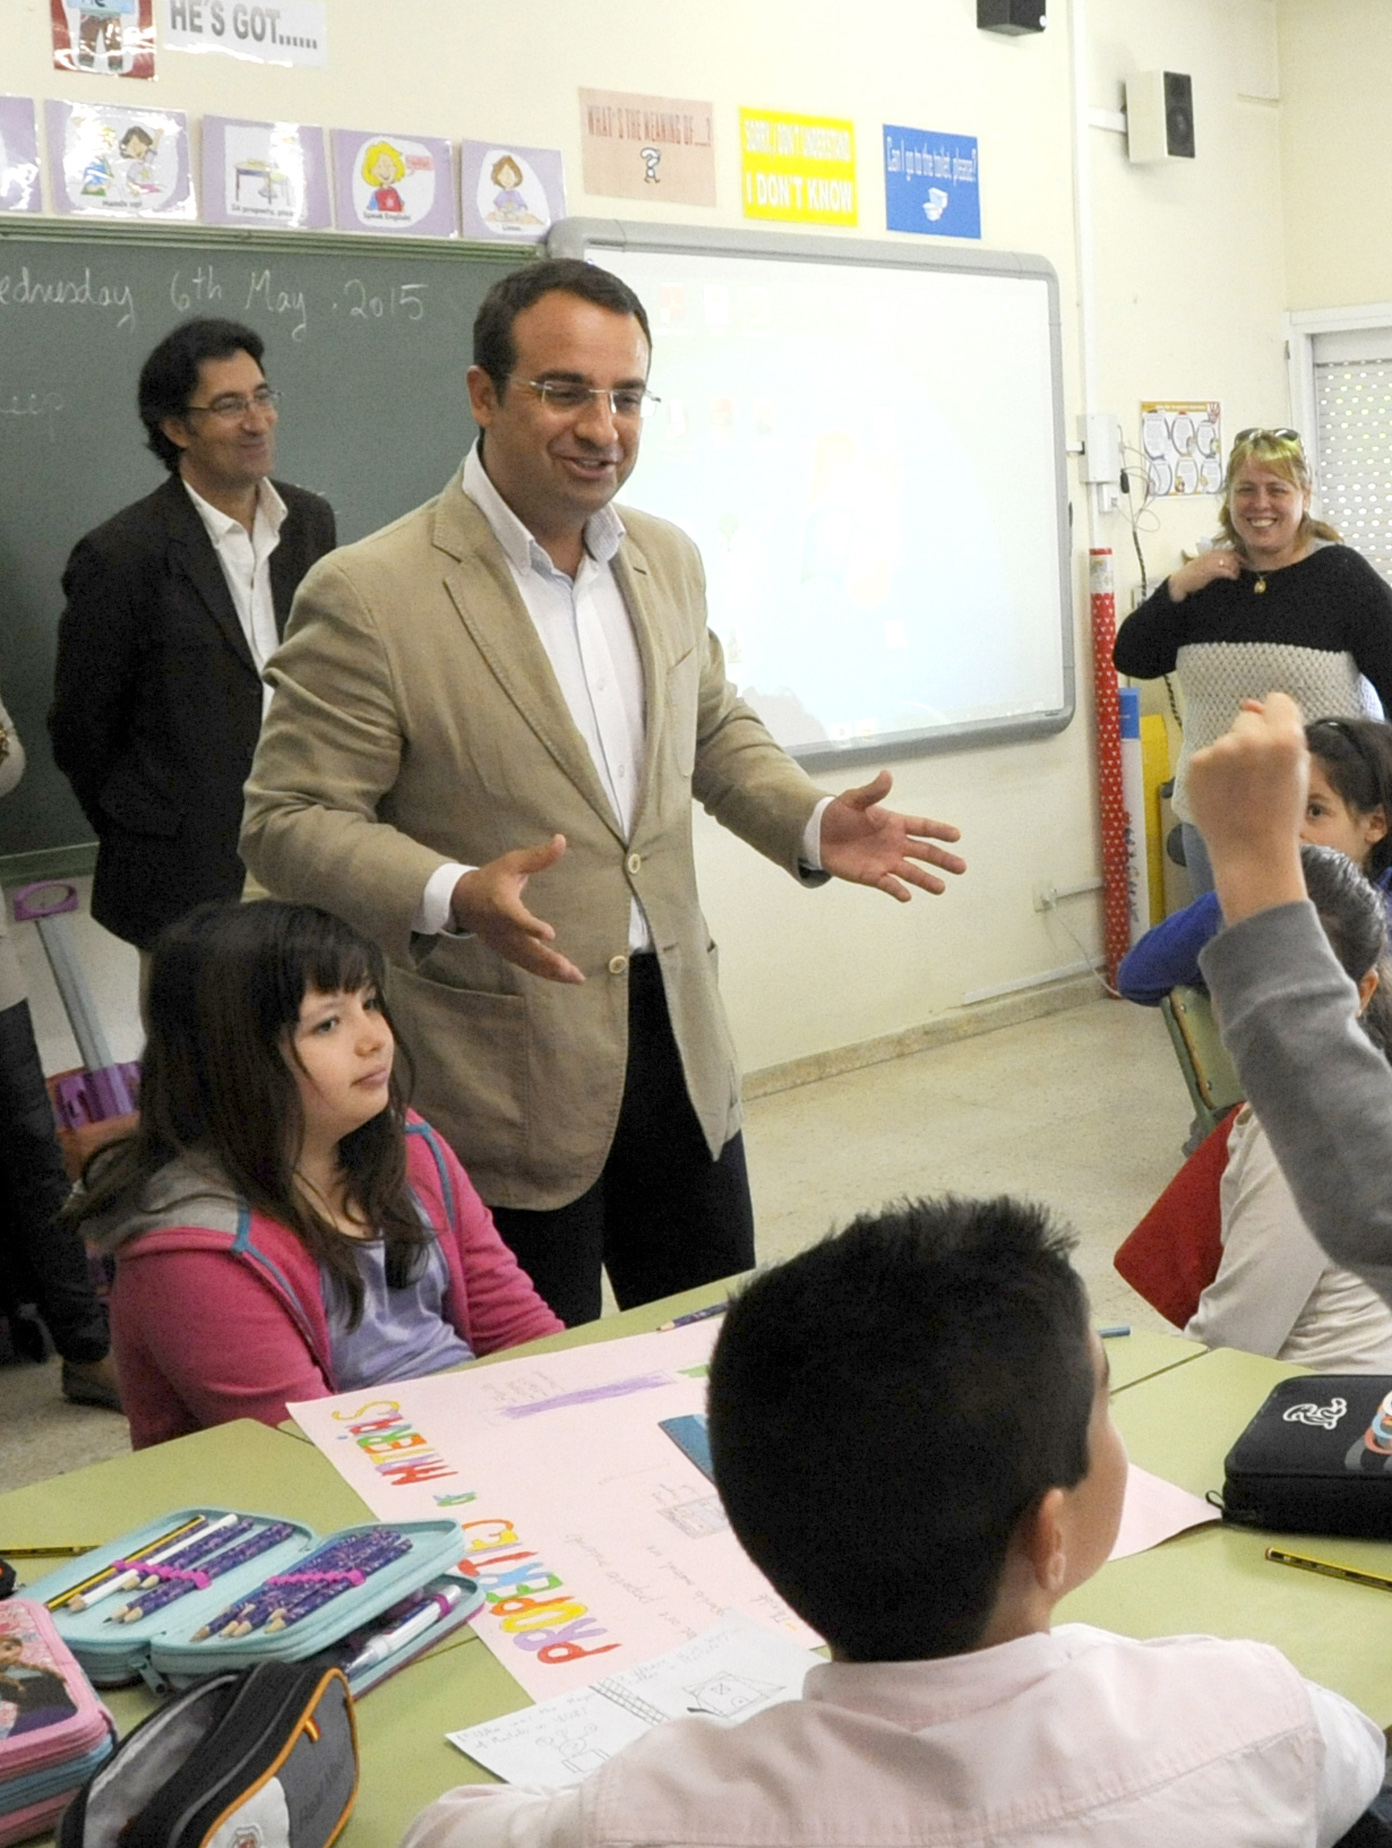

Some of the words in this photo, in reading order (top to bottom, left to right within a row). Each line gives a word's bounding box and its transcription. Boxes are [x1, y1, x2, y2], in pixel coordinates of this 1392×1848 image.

[886, 135, 900, 172] Can
[746, 171, 753, 206] I
[756, 171, 803, 211] DON'T
[807, 178, 853, 213] KNOW
[0, 266, 135, 332] ednesday
[170, 265, 222, 311] 6th
[244, 269, 307, 342] May
